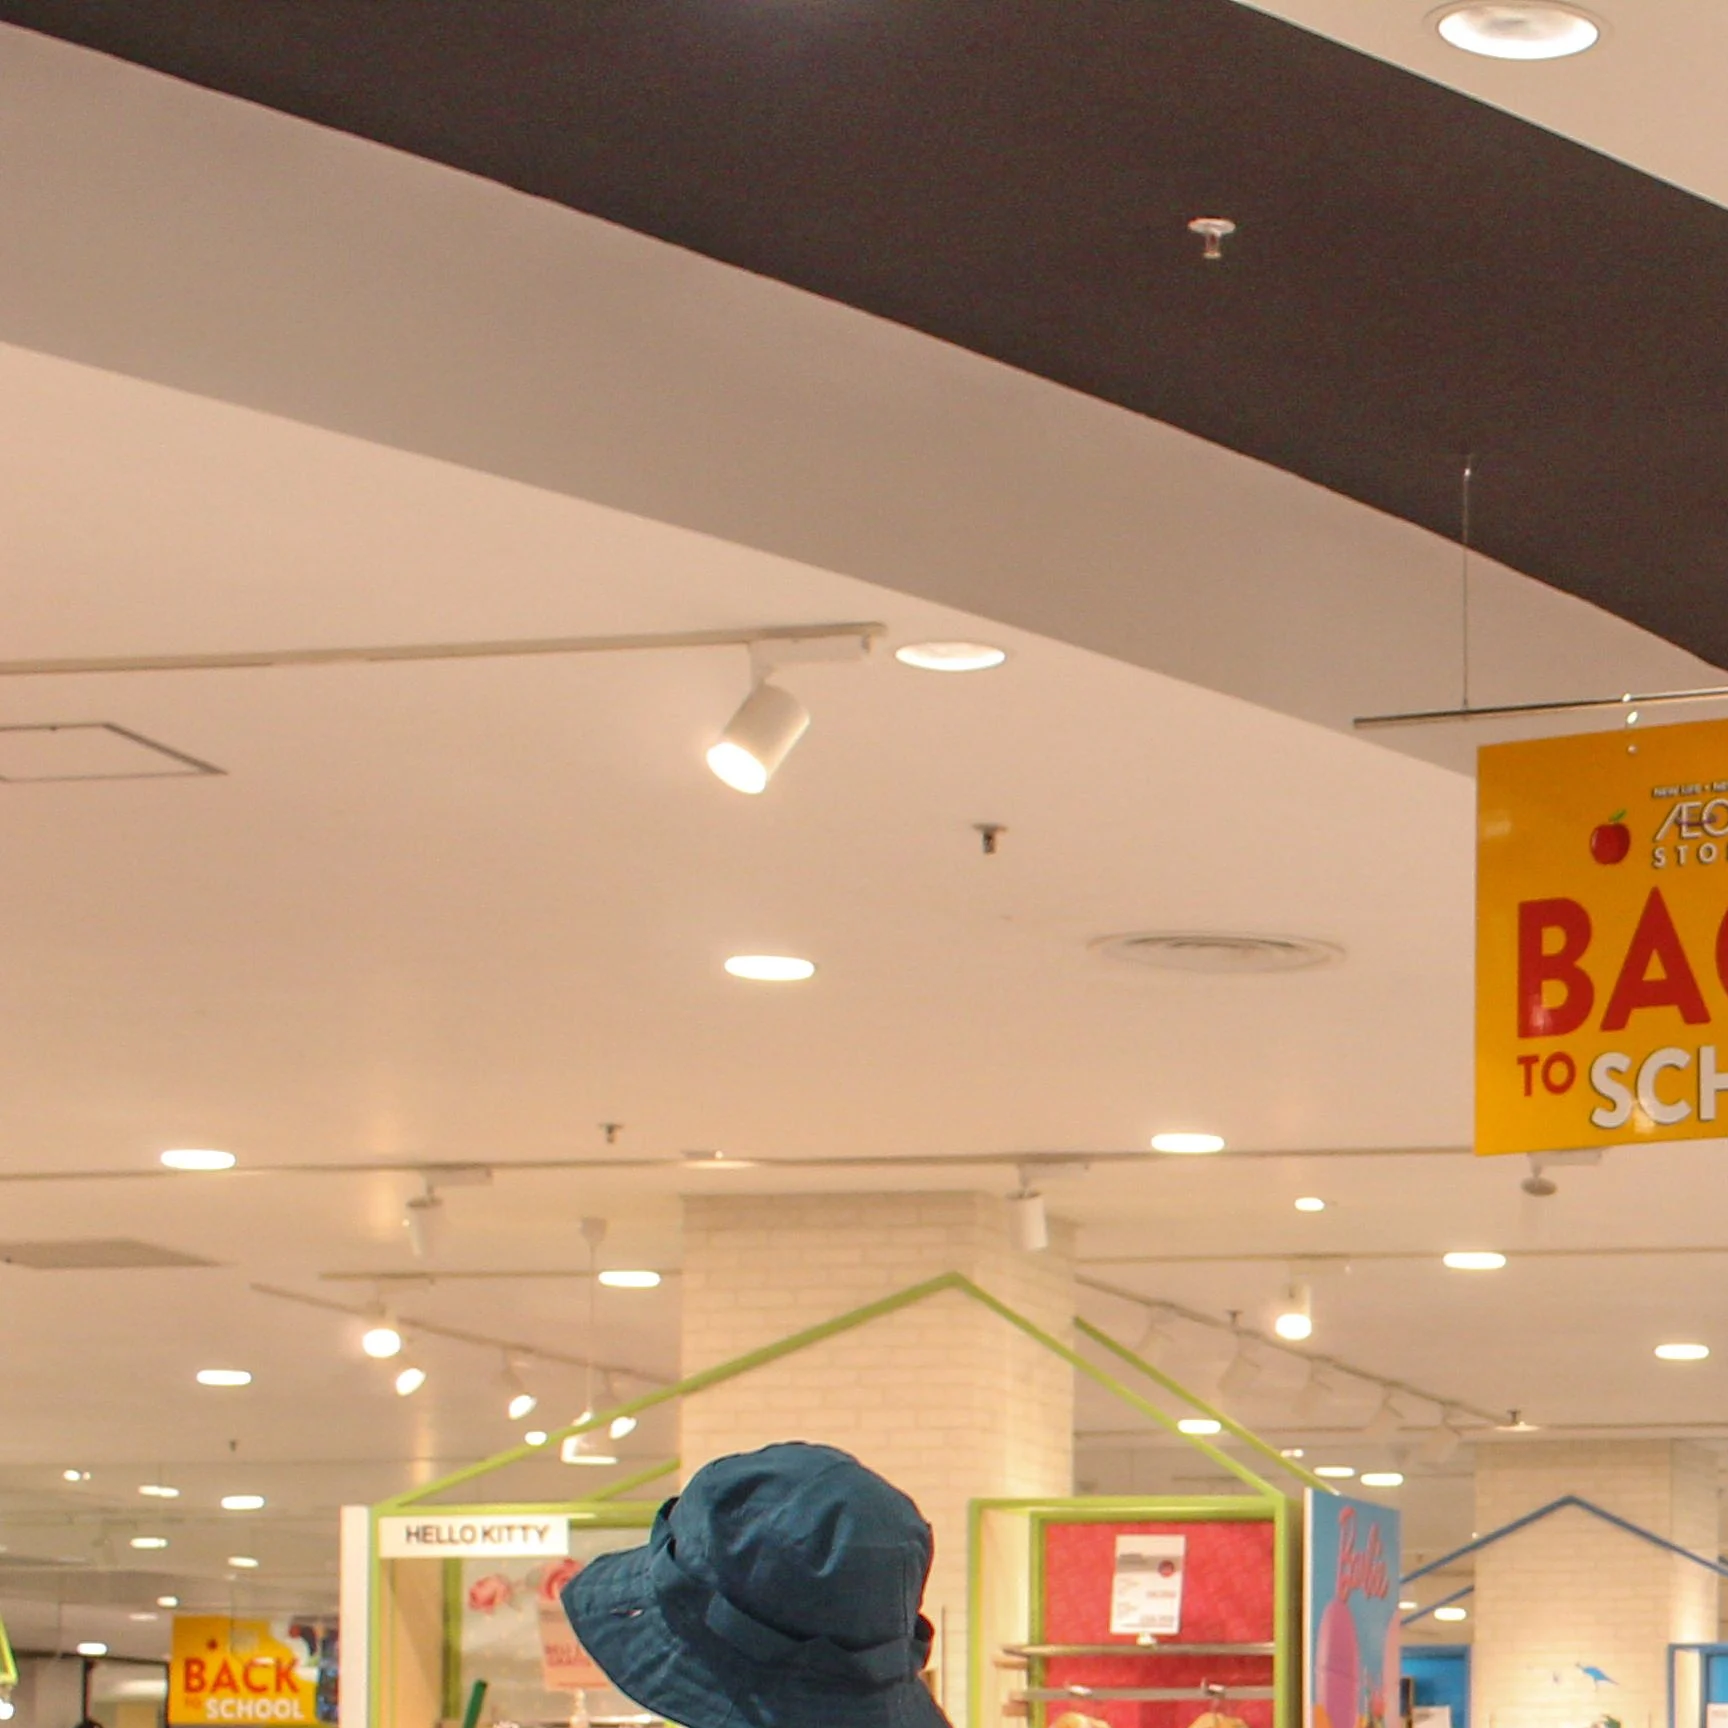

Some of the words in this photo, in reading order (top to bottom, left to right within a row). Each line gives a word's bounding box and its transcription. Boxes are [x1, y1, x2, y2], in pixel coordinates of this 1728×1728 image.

[1516, 1051, 1575, 1098] TO
[405, 1524, 477, 1545] HELLO
[482, 1524, 550, 1543] KITTY
[184, 1658, 300, 1693] BACK
[205, 1697, 305, 1720] SCHOOL
